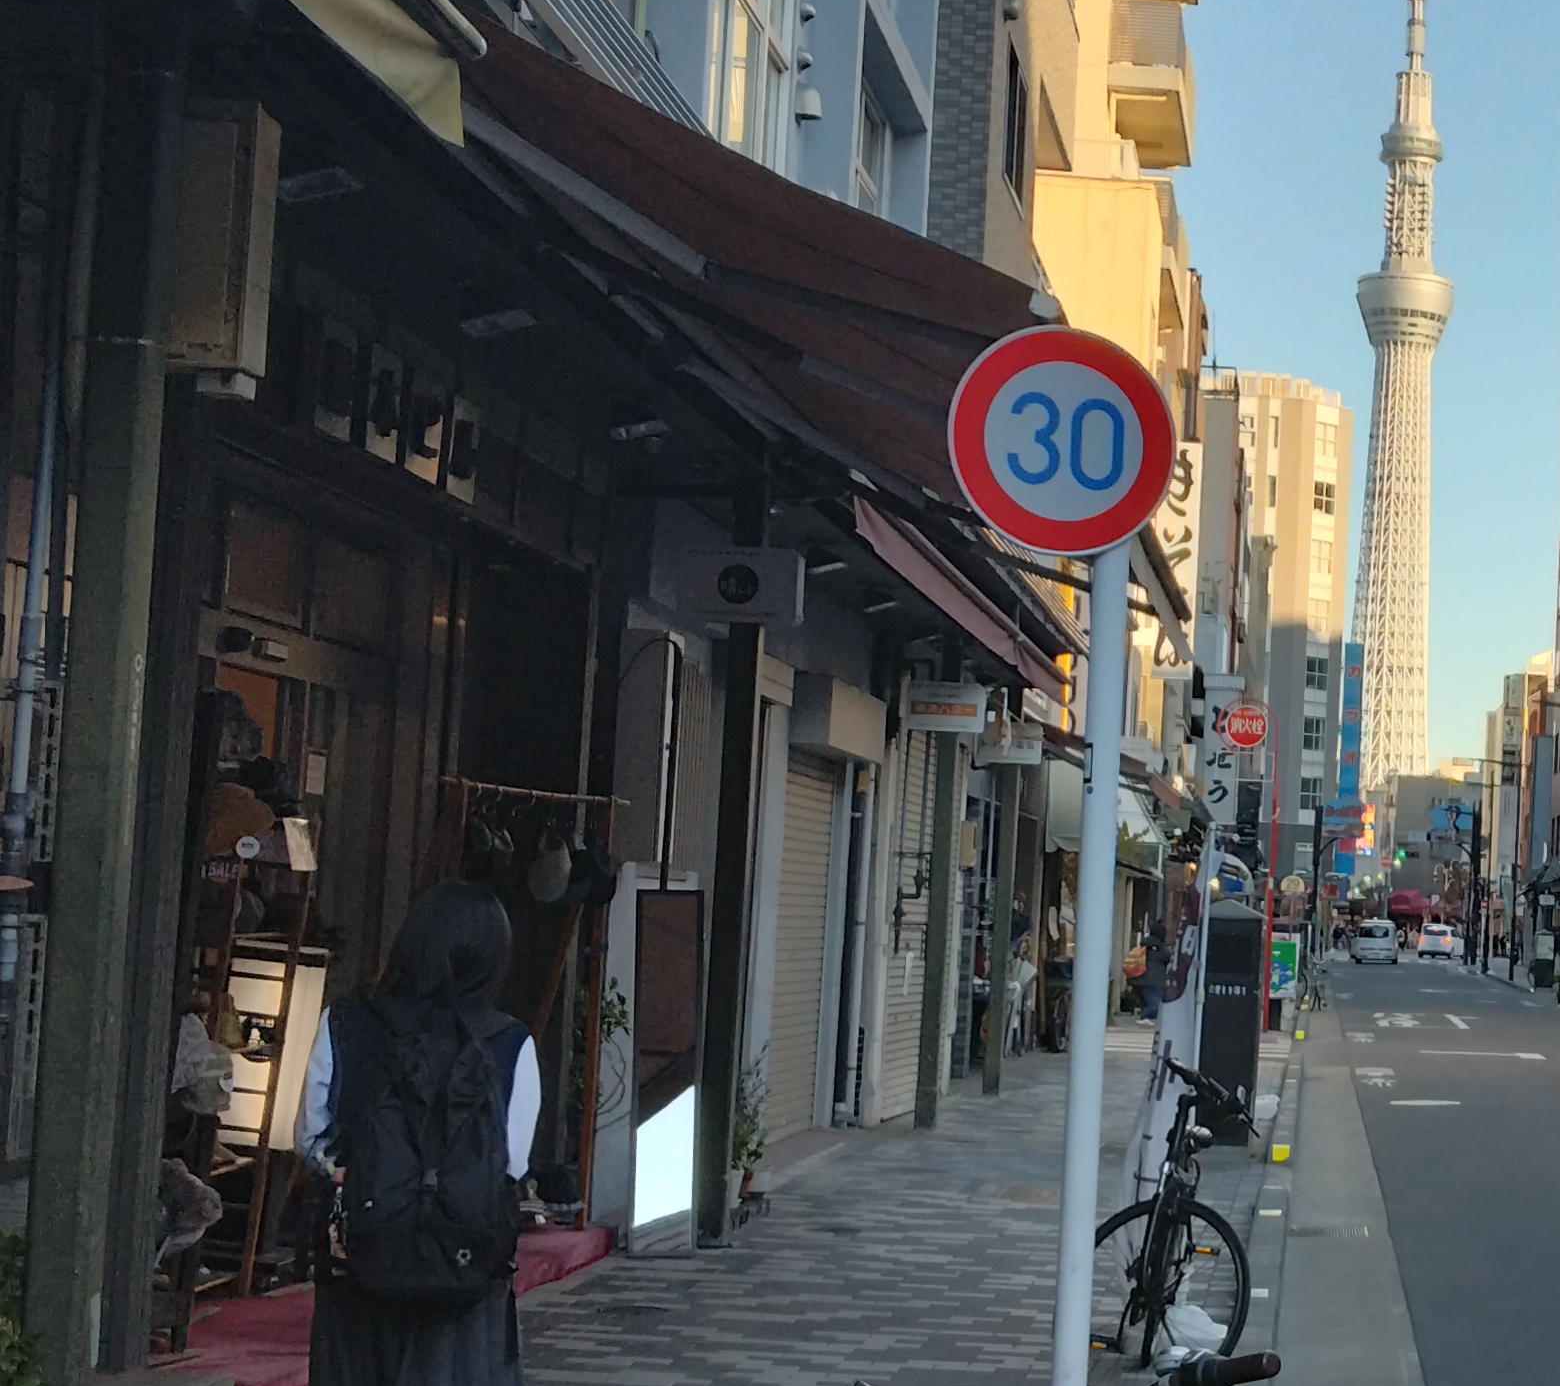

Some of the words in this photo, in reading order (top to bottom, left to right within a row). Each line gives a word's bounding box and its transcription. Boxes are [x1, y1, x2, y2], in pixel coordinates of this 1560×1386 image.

[1004, 389, 1127, 493] 30
[1230, 716, 1265, 735] 消火栓
[1285, 877, 1300, 890] 29
